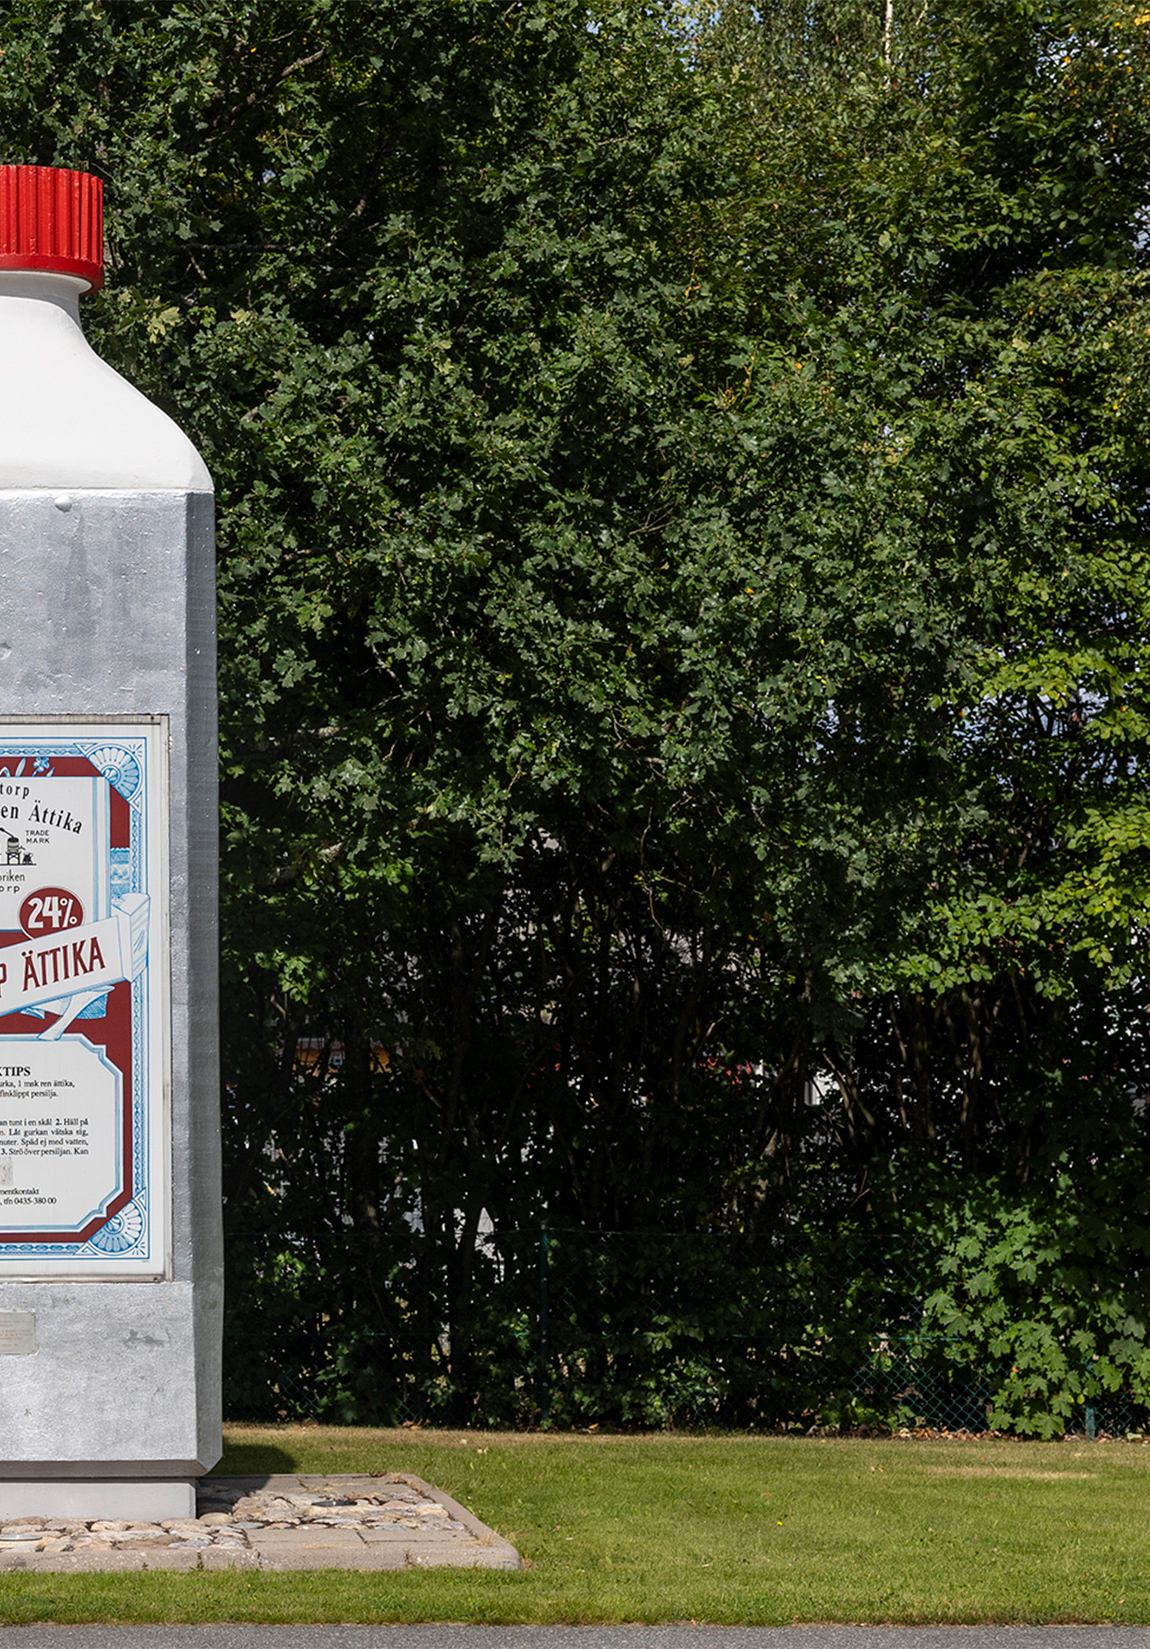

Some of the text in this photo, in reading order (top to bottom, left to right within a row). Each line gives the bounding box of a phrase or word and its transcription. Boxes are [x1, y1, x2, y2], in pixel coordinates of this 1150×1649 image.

[28, 800, 82, 835] Ättika
[27, 897, 77, 929] 24%
[21, 937, 106, 991] ÄTTIKA
[0, 1090, 29, 1098] finklippt
[31, 1090, 58, 1098] persilja.
[80, 1118, 88, 1127] på
[24, 1128, 48, 1137] gurkan
[21, 1138, 38, 1146] Späd
[40, 1138, 47, 1147] ej
